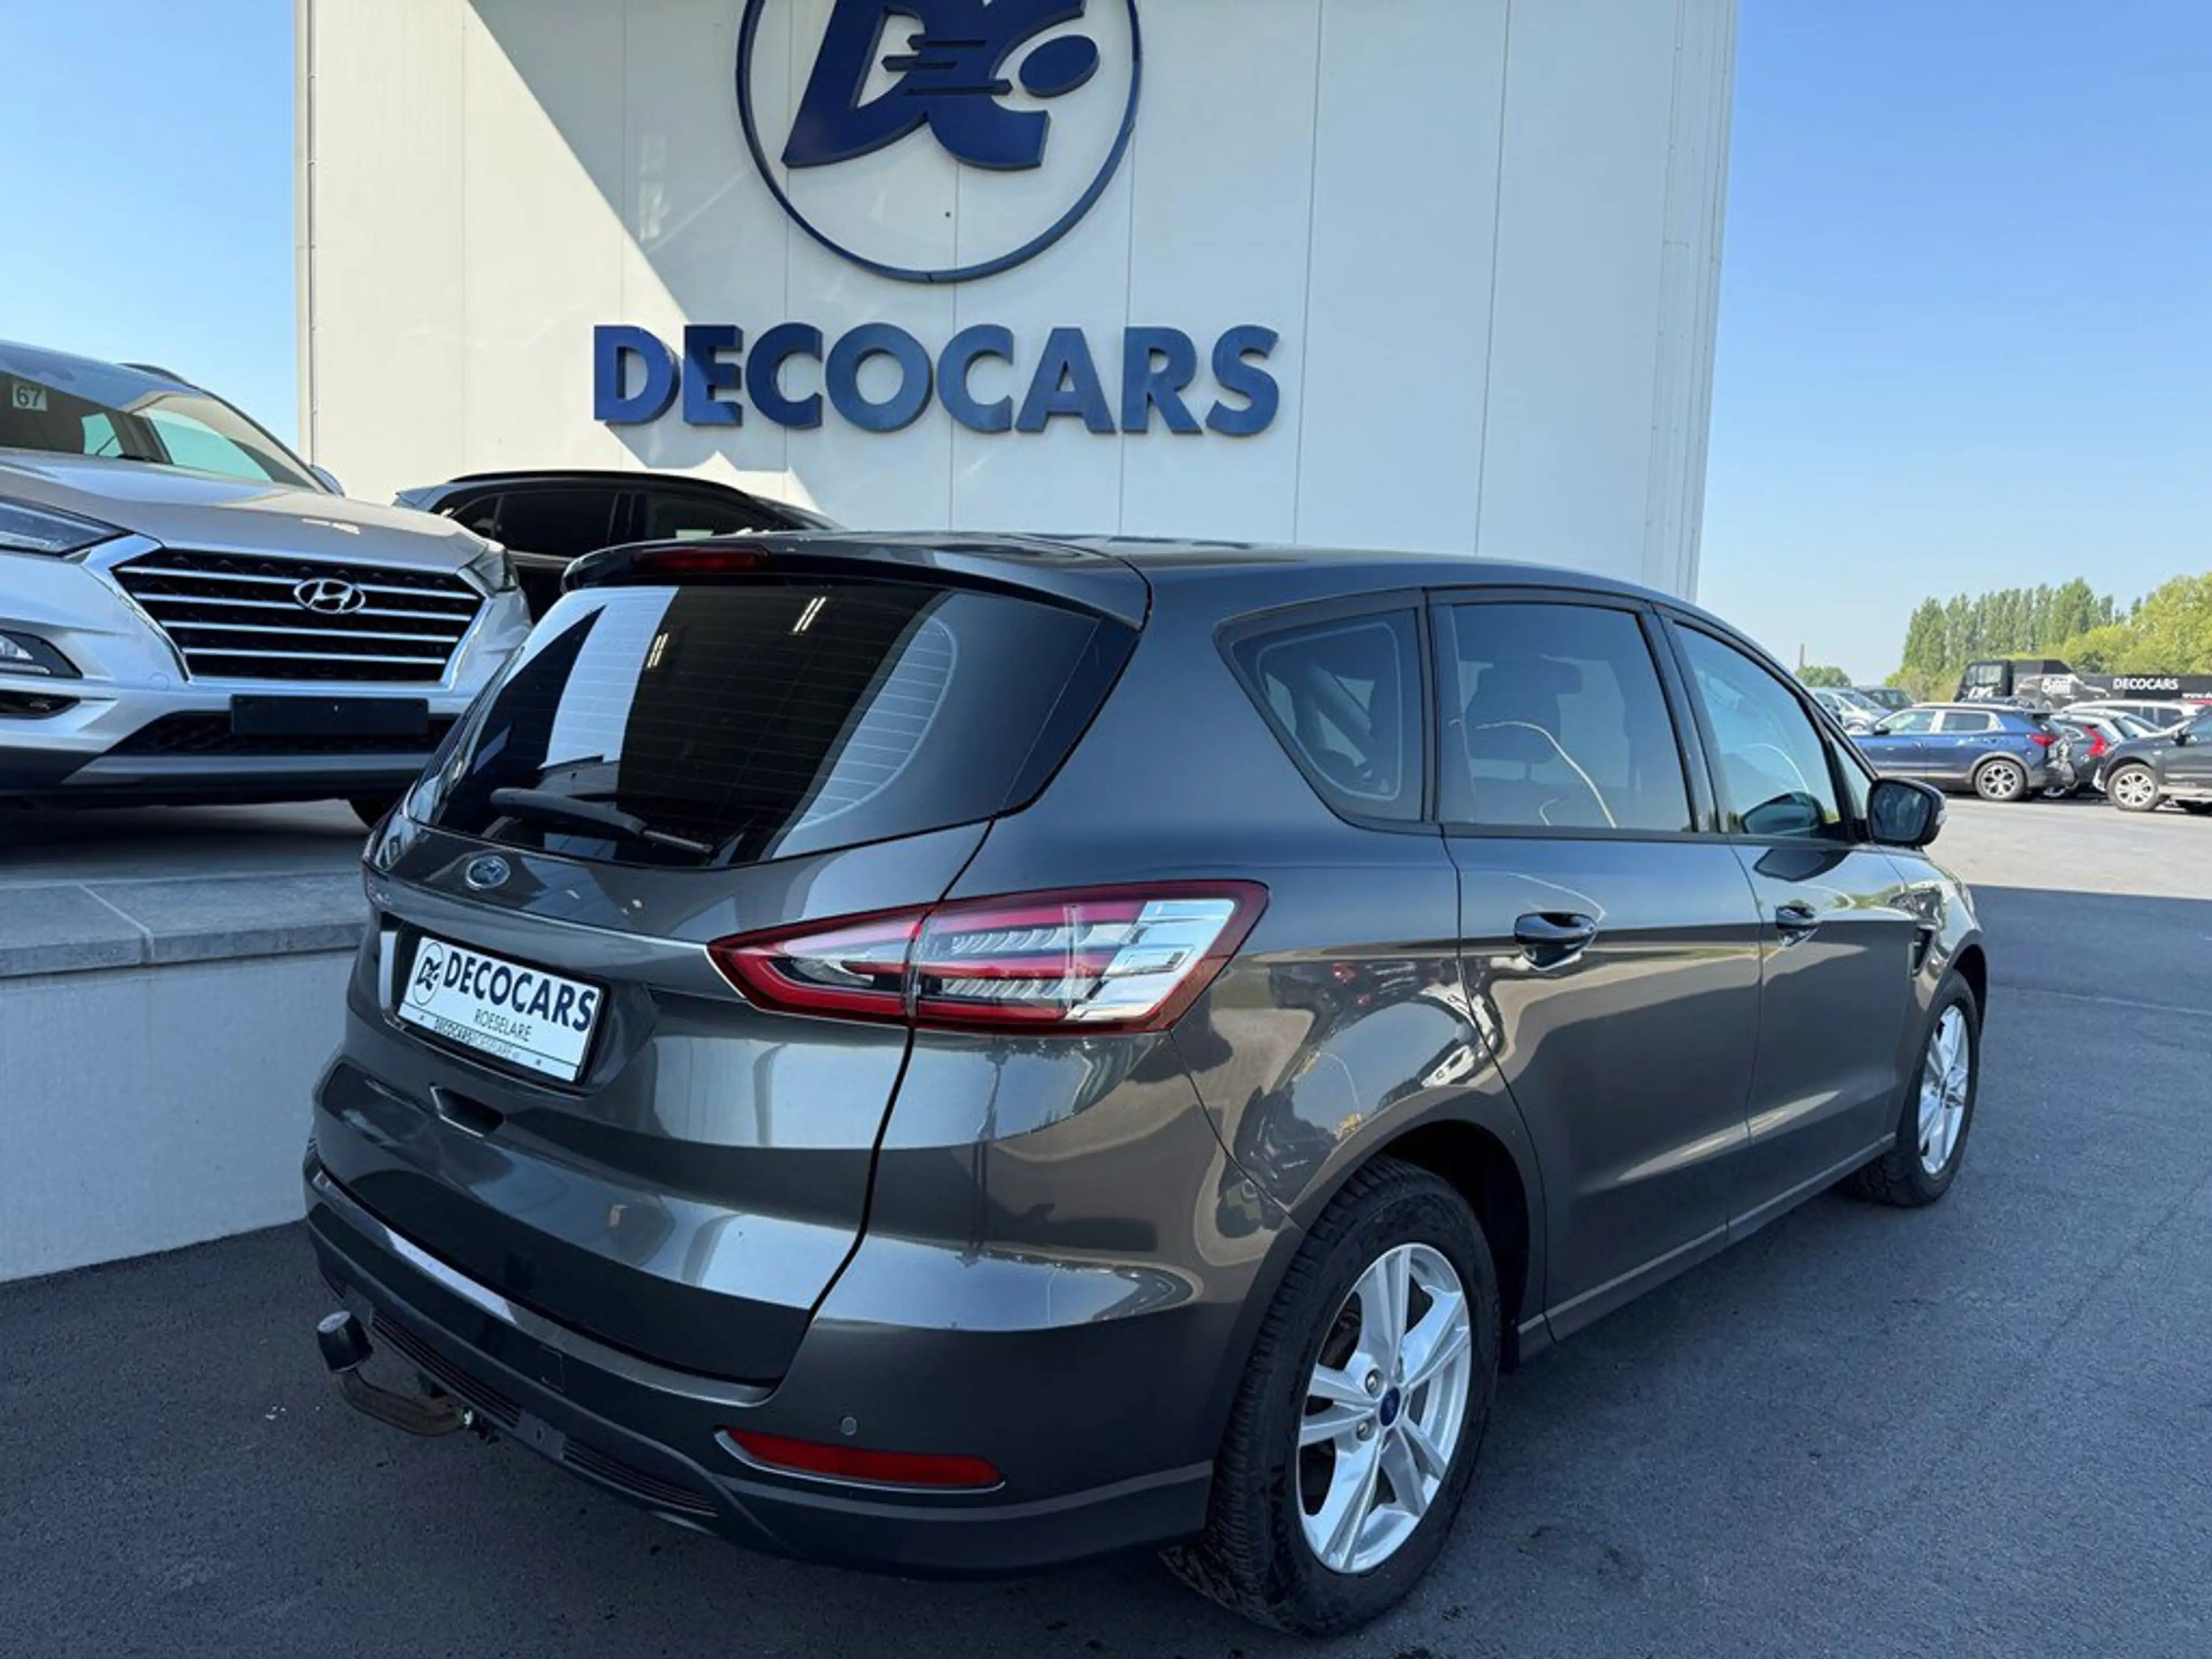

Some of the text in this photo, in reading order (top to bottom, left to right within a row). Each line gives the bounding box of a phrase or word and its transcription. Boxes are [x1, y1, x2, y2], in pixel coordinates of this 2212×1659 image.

[17, 385, 42, 407] 67
[594, 322, 1280, 437] DECOCARS
[2113, 677, 2179, 690] DECOCARS
[443, 952, 596, 1032] DECOCARS
